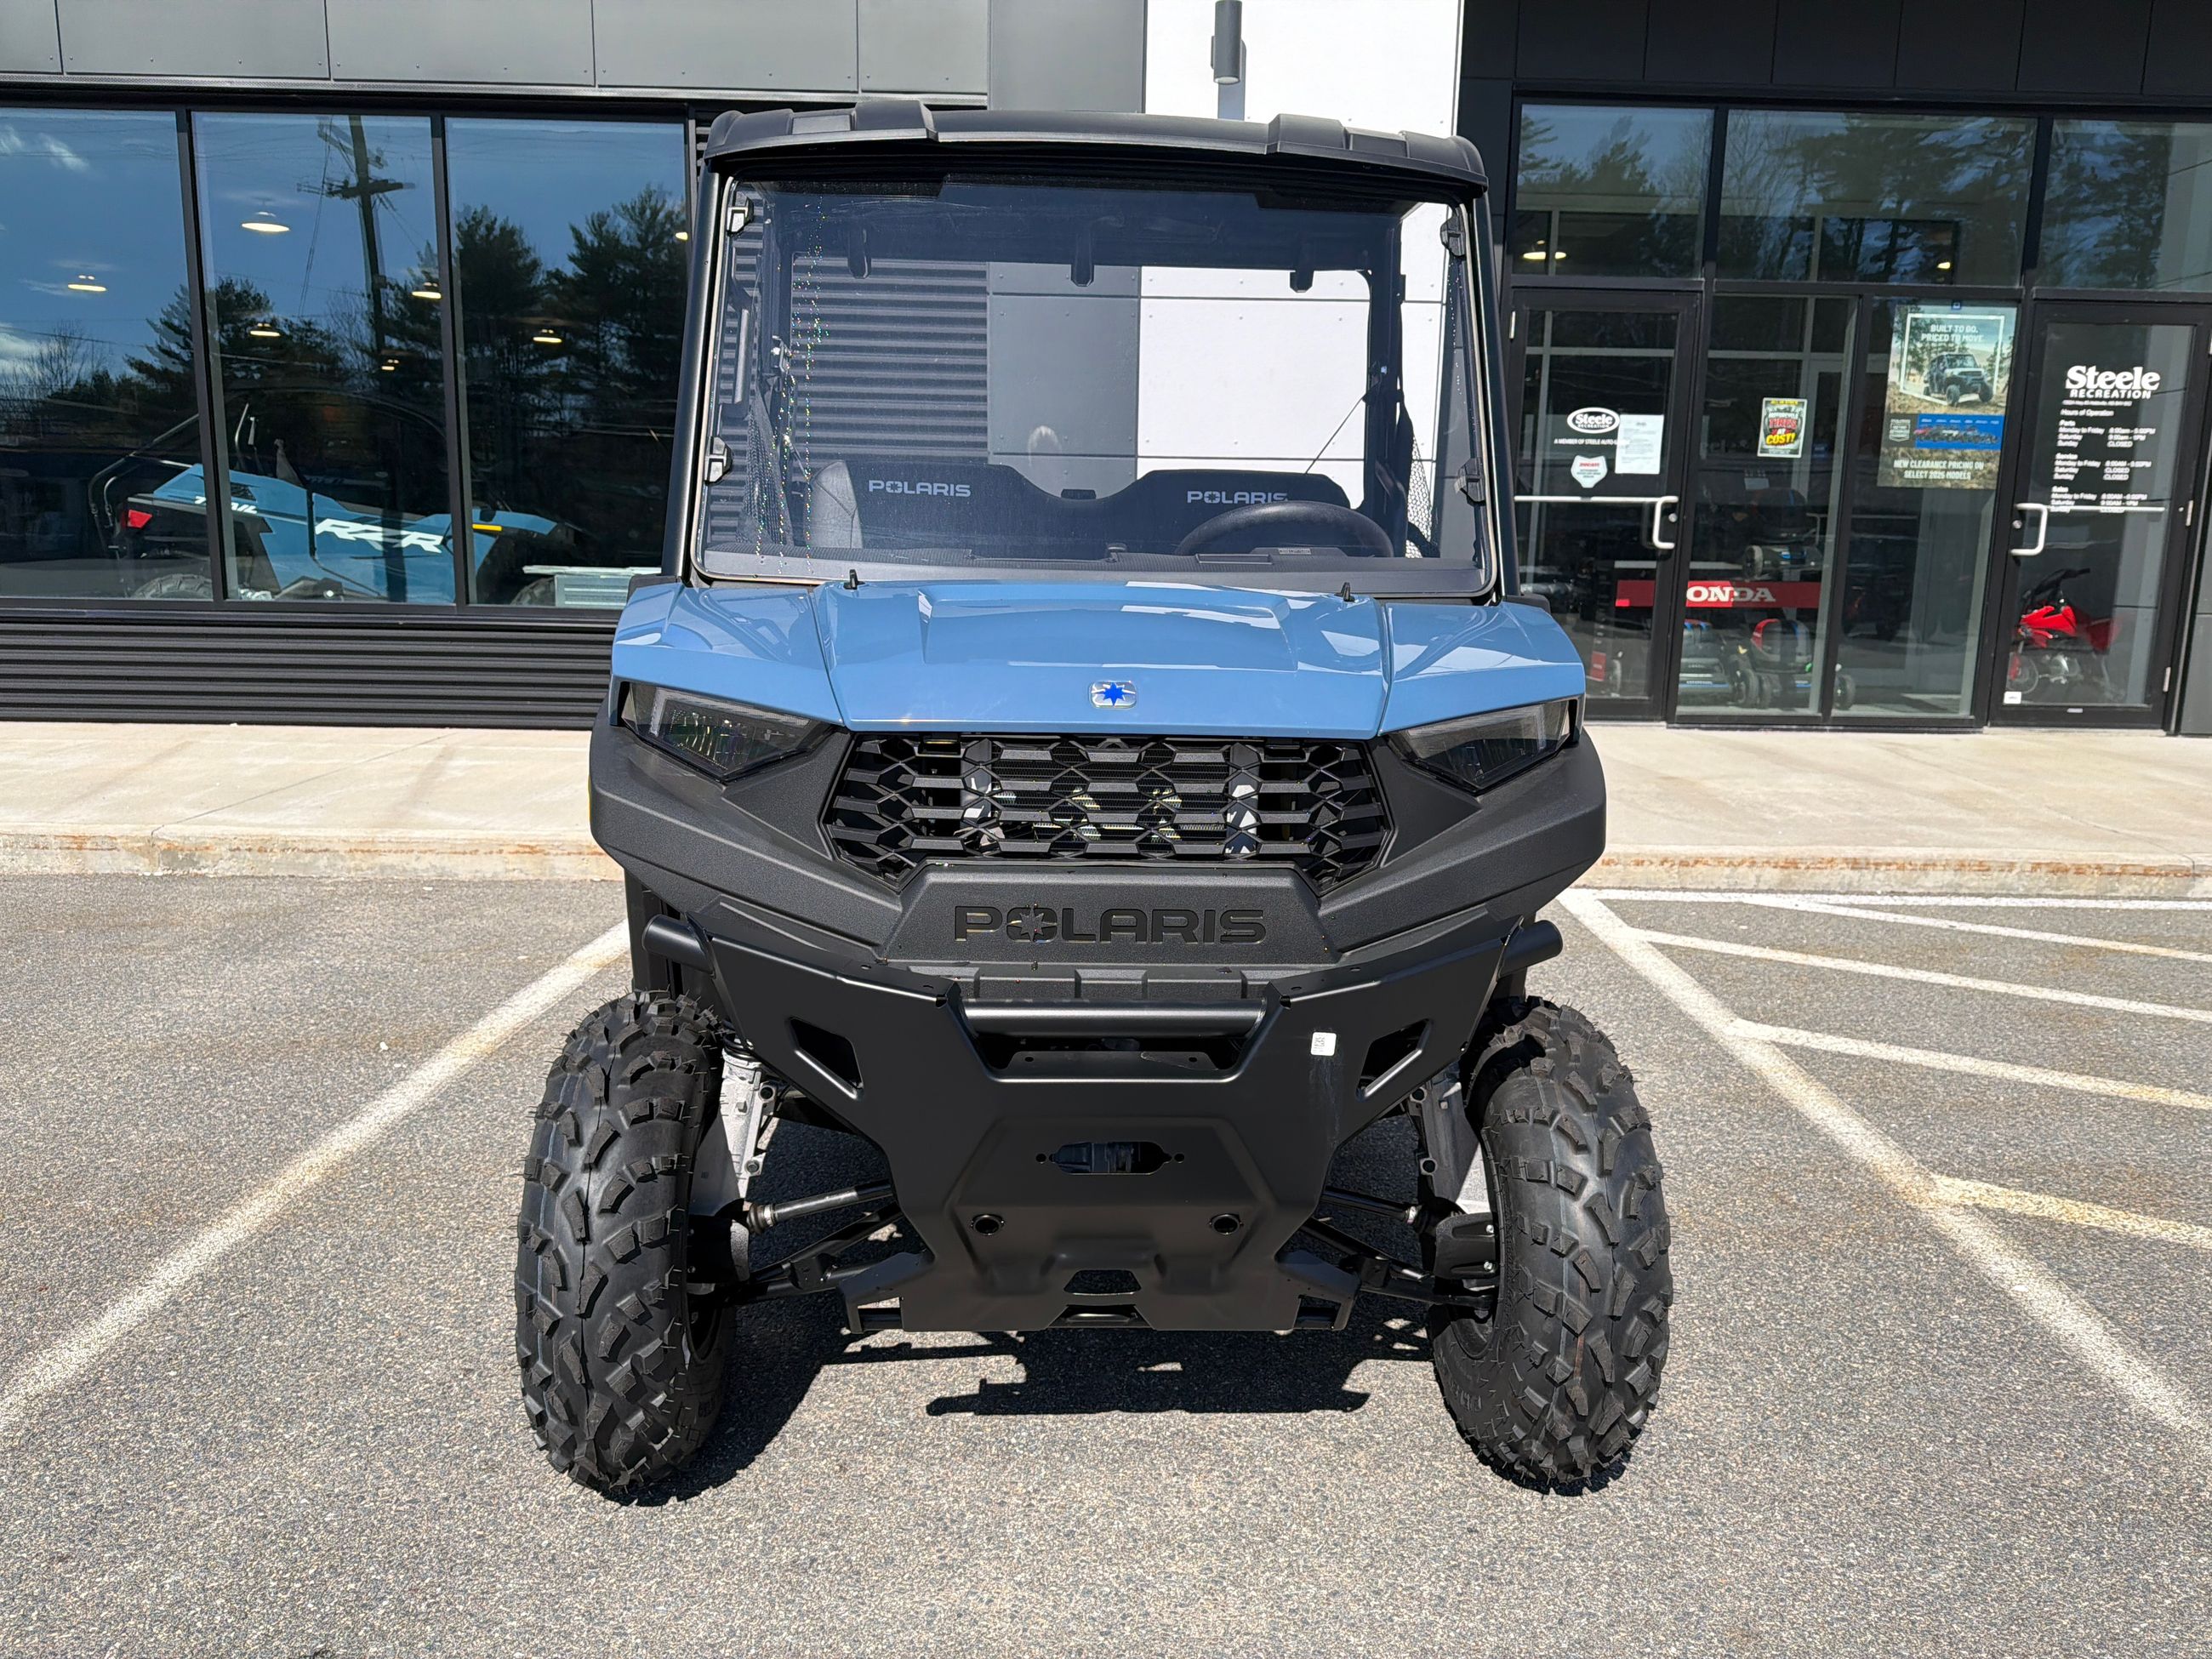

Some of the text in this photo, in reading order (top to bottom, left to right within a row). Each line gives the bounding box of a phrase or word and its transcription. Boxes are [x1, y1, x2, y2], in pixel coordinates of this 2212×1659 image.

[1930, 324, 1953, 333] BUILT
[1921, 333, 1949, 341] PRICED
[1951, 334, 1961, 342] TO
[2065, 365, 2161, 390] Steele
[2069, 389, 2152, 399] RECREATION
[1575, 413, 1614, 425] Steele
[1769, 417, 1798, 430] TIRES
[1765, 432, 1797, 446] COST!
[1893, 459, 1985, 470] NEW CLEARANCE PRICING ON
[2084, 459, 2101, 468] Friday
[1903, 470, 1928, 479] SELECT
[1946, 471, 1972, 480] MODELS
[868, 479, 972, 498] POLARIS
[1186, 490, 1288, 505] POLARIS
[194, 495, 258, 515] TAIL
[315, 518, 444, 554] RZR
[1685, 584, 1776, 602] ONDA
[954, 905, 1268, 945] POLARIS
